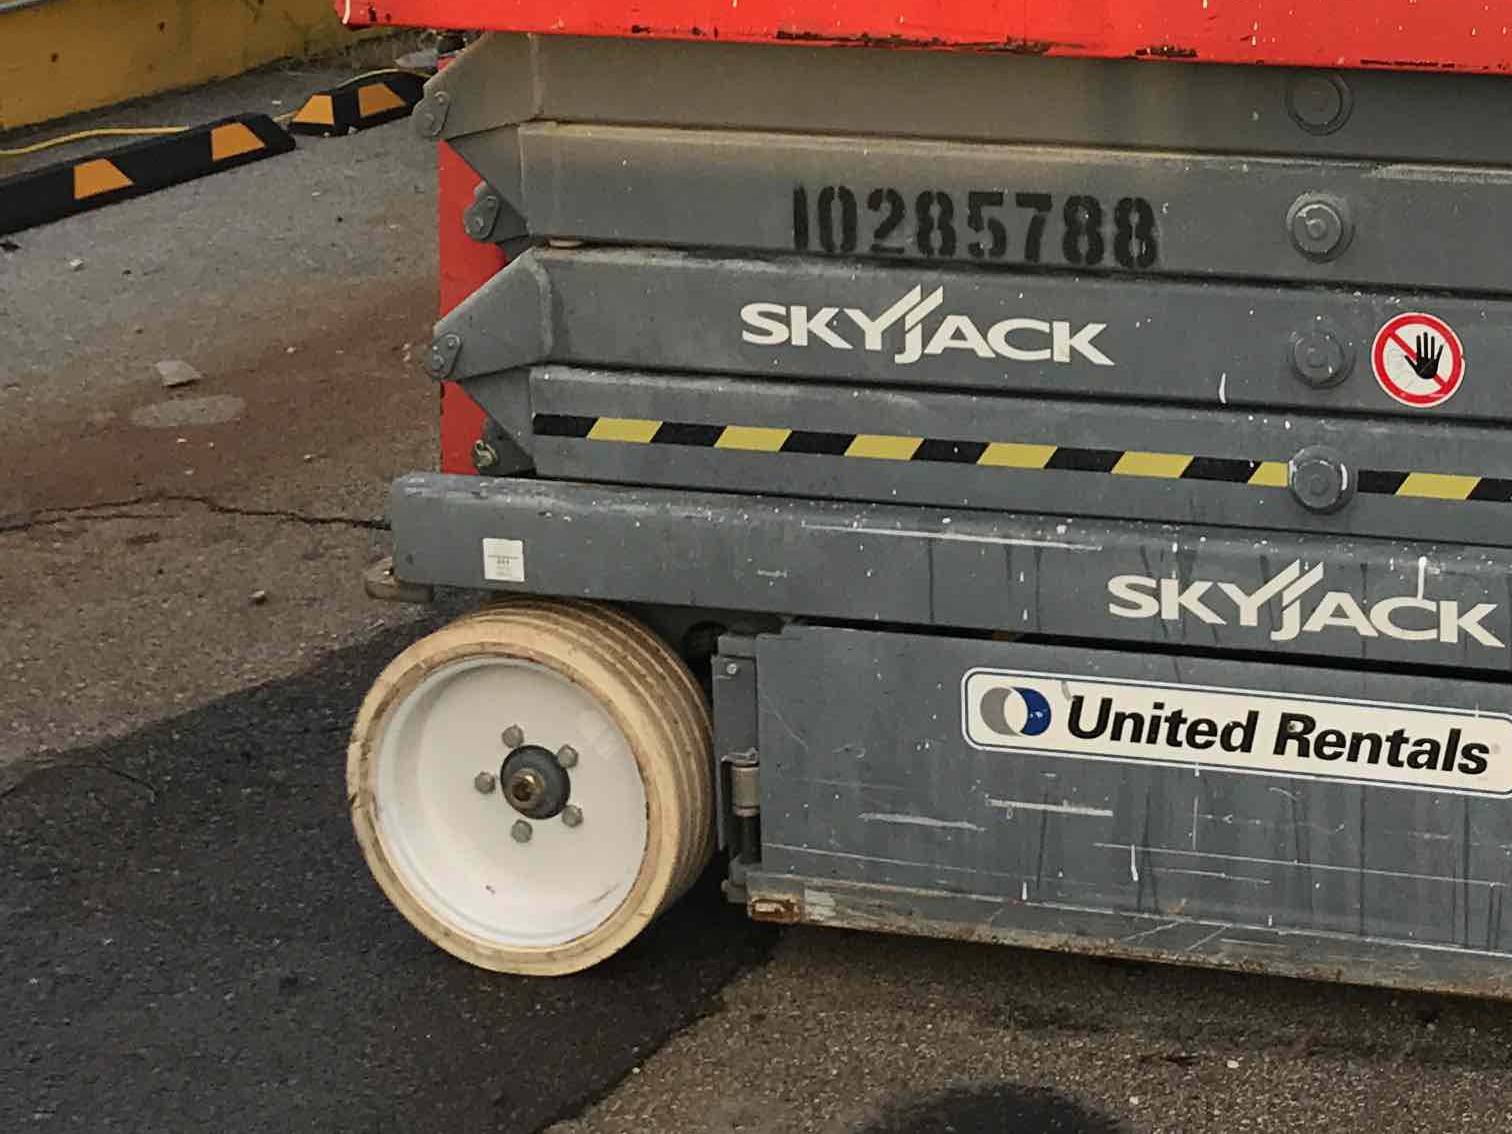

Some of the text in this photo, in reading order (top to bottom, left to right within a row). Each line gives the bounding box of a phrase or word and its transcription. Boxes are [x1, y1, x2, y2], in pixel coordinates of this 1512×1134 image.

[792, 182, 1158, 268] 10285788
[739, 282, 1116, 367] SKYJACK
[1105, 559, 1507, 648] SKYJACK
[1066, 694, 1491, 776] United Rentals
